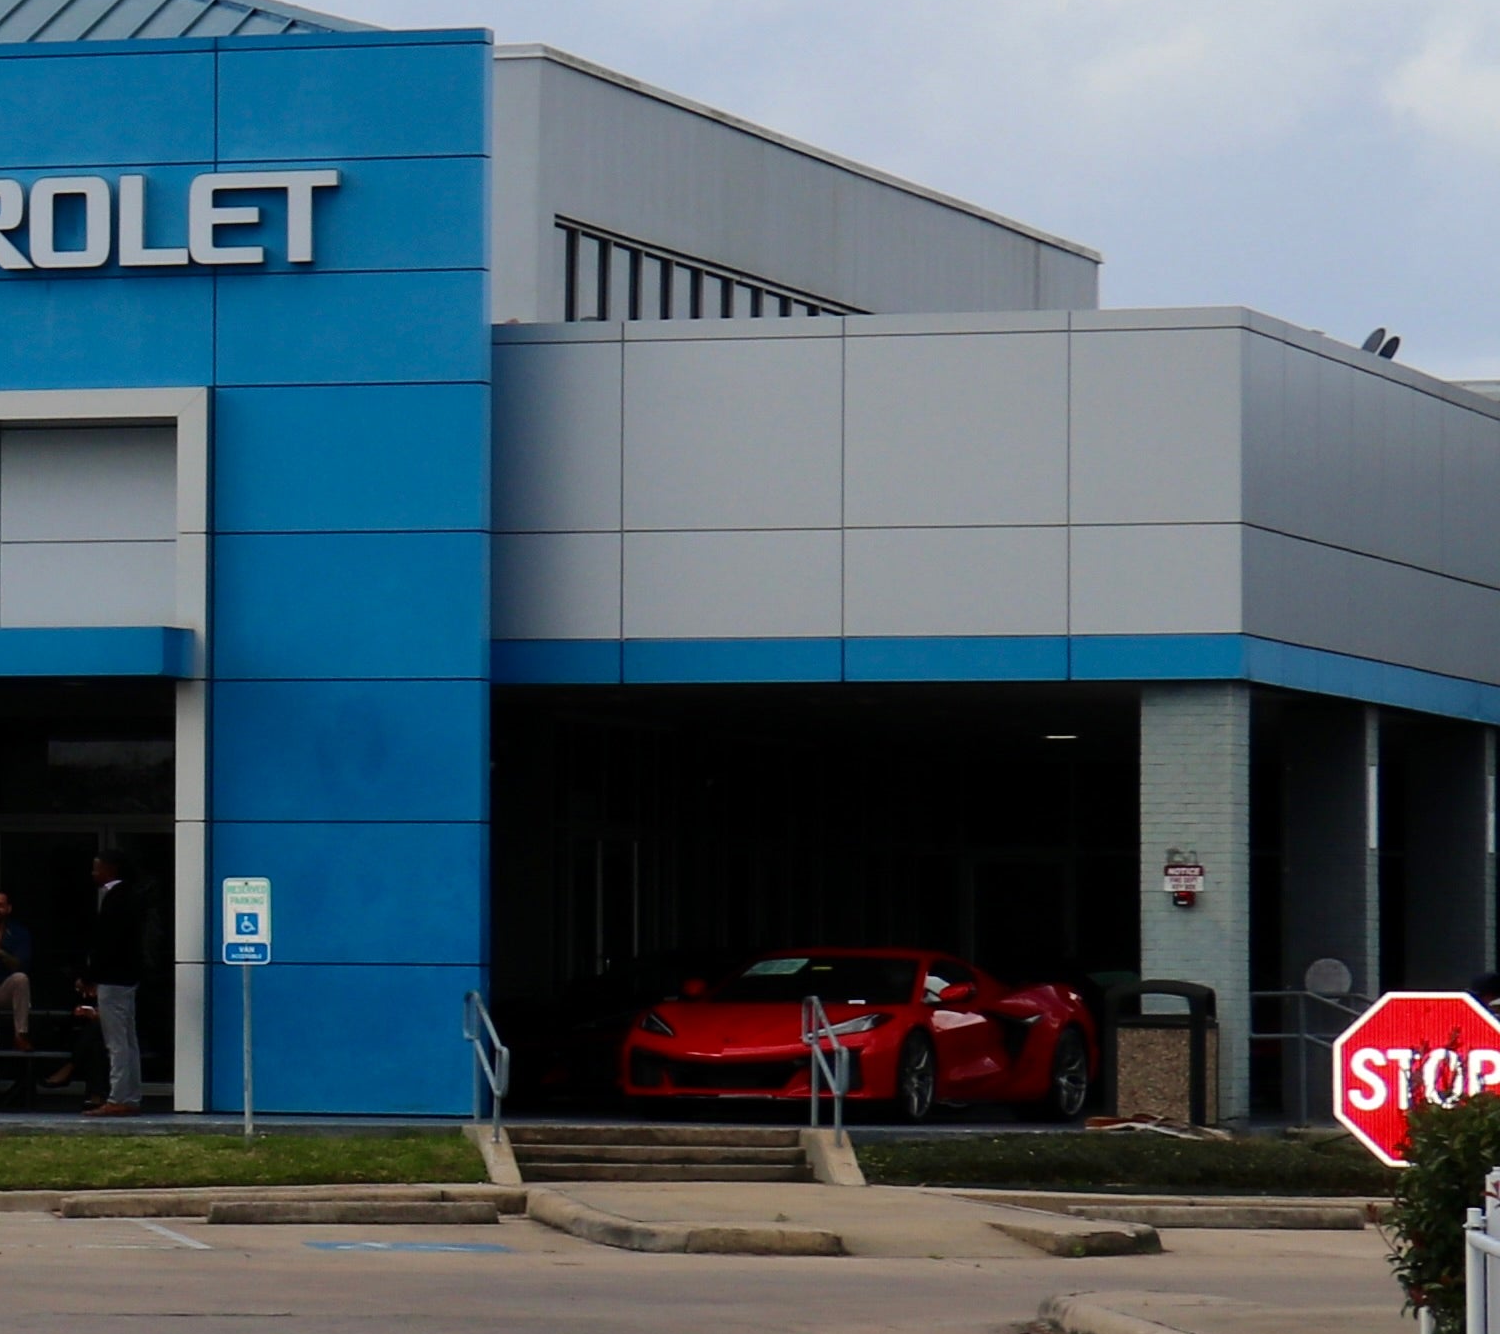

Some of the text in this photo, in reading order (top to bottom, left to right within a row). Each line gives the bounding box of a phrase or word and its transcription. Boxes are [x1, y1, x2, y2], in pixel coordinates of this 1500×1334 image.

[1167, 867, 1200, 876] NOTICE
[227, 885, 269, 894] RESERVED
[229, 896, 264, 905] PARKING
[1347, 1047, 1500, 1112] STOP
